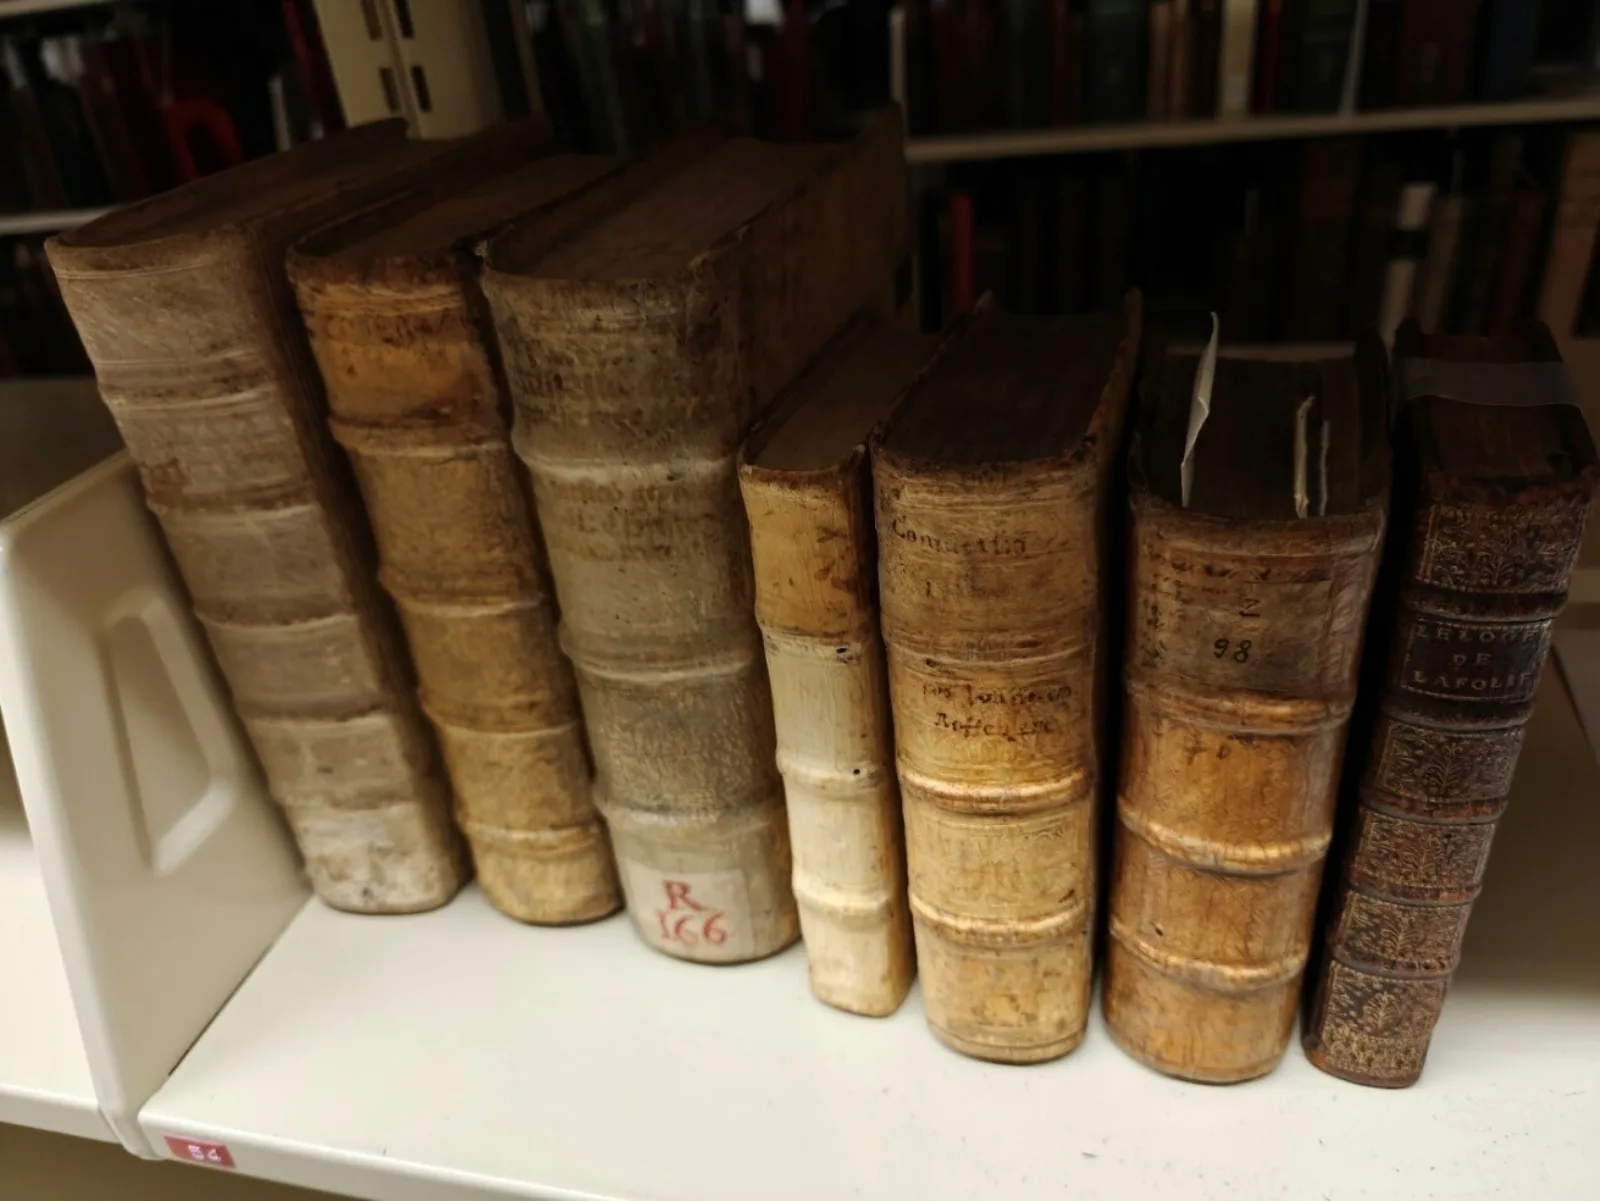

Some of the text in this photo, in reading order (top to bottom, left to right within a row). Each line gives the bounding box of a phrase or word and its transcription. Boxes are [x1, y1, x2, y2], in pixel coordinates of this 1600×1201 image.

[1213, 638, 1253, 664] 98
[1453, 652, 1494, 667] DE
[662, 880, 705, 912] R
